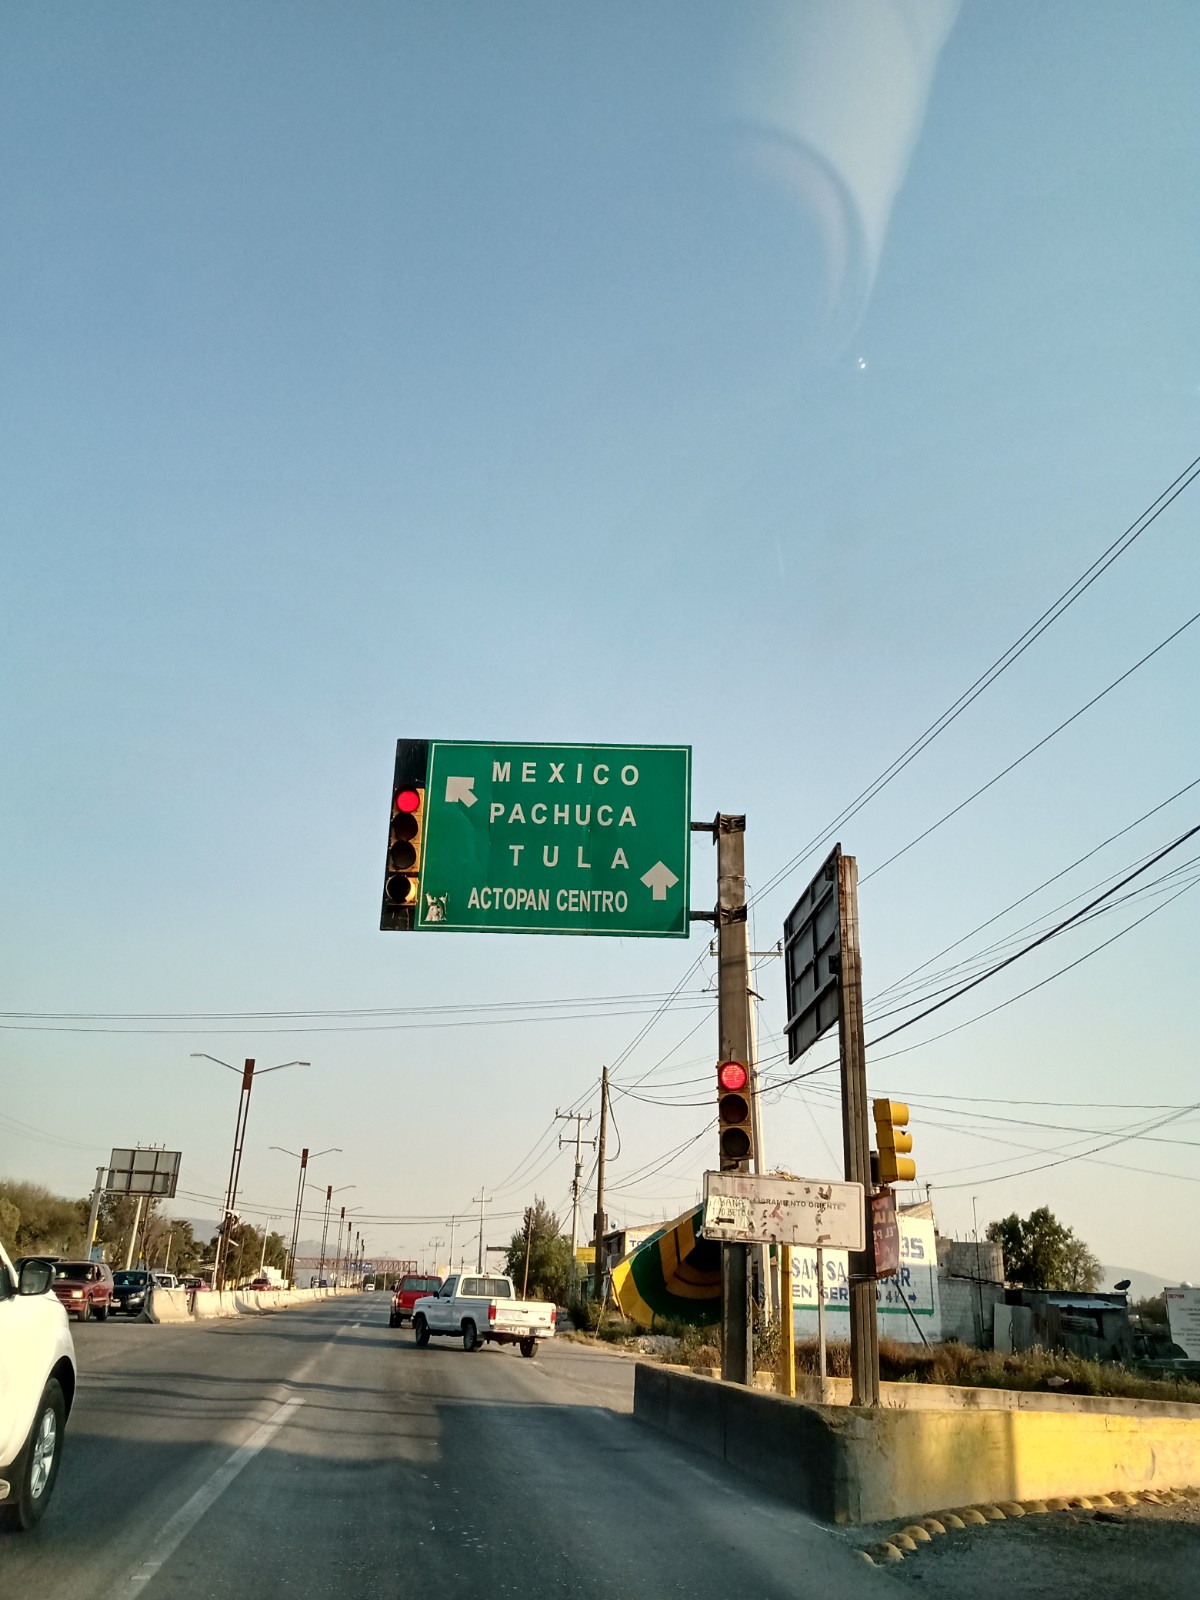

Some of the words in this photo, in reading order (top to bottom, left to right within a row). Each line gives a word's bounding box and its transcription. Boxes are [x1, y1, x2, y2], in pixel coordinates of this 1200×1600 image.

[492, 761, 639, 786] MEXICO
[489, 803, 637, 827] PACHUCA
[509, 845, 629, 869] TULA
[467, 887, 550, 911] ACTOPAN
[556, 889, 628, 912] CENTRO
[792, 1284, 812, 1298] EN
